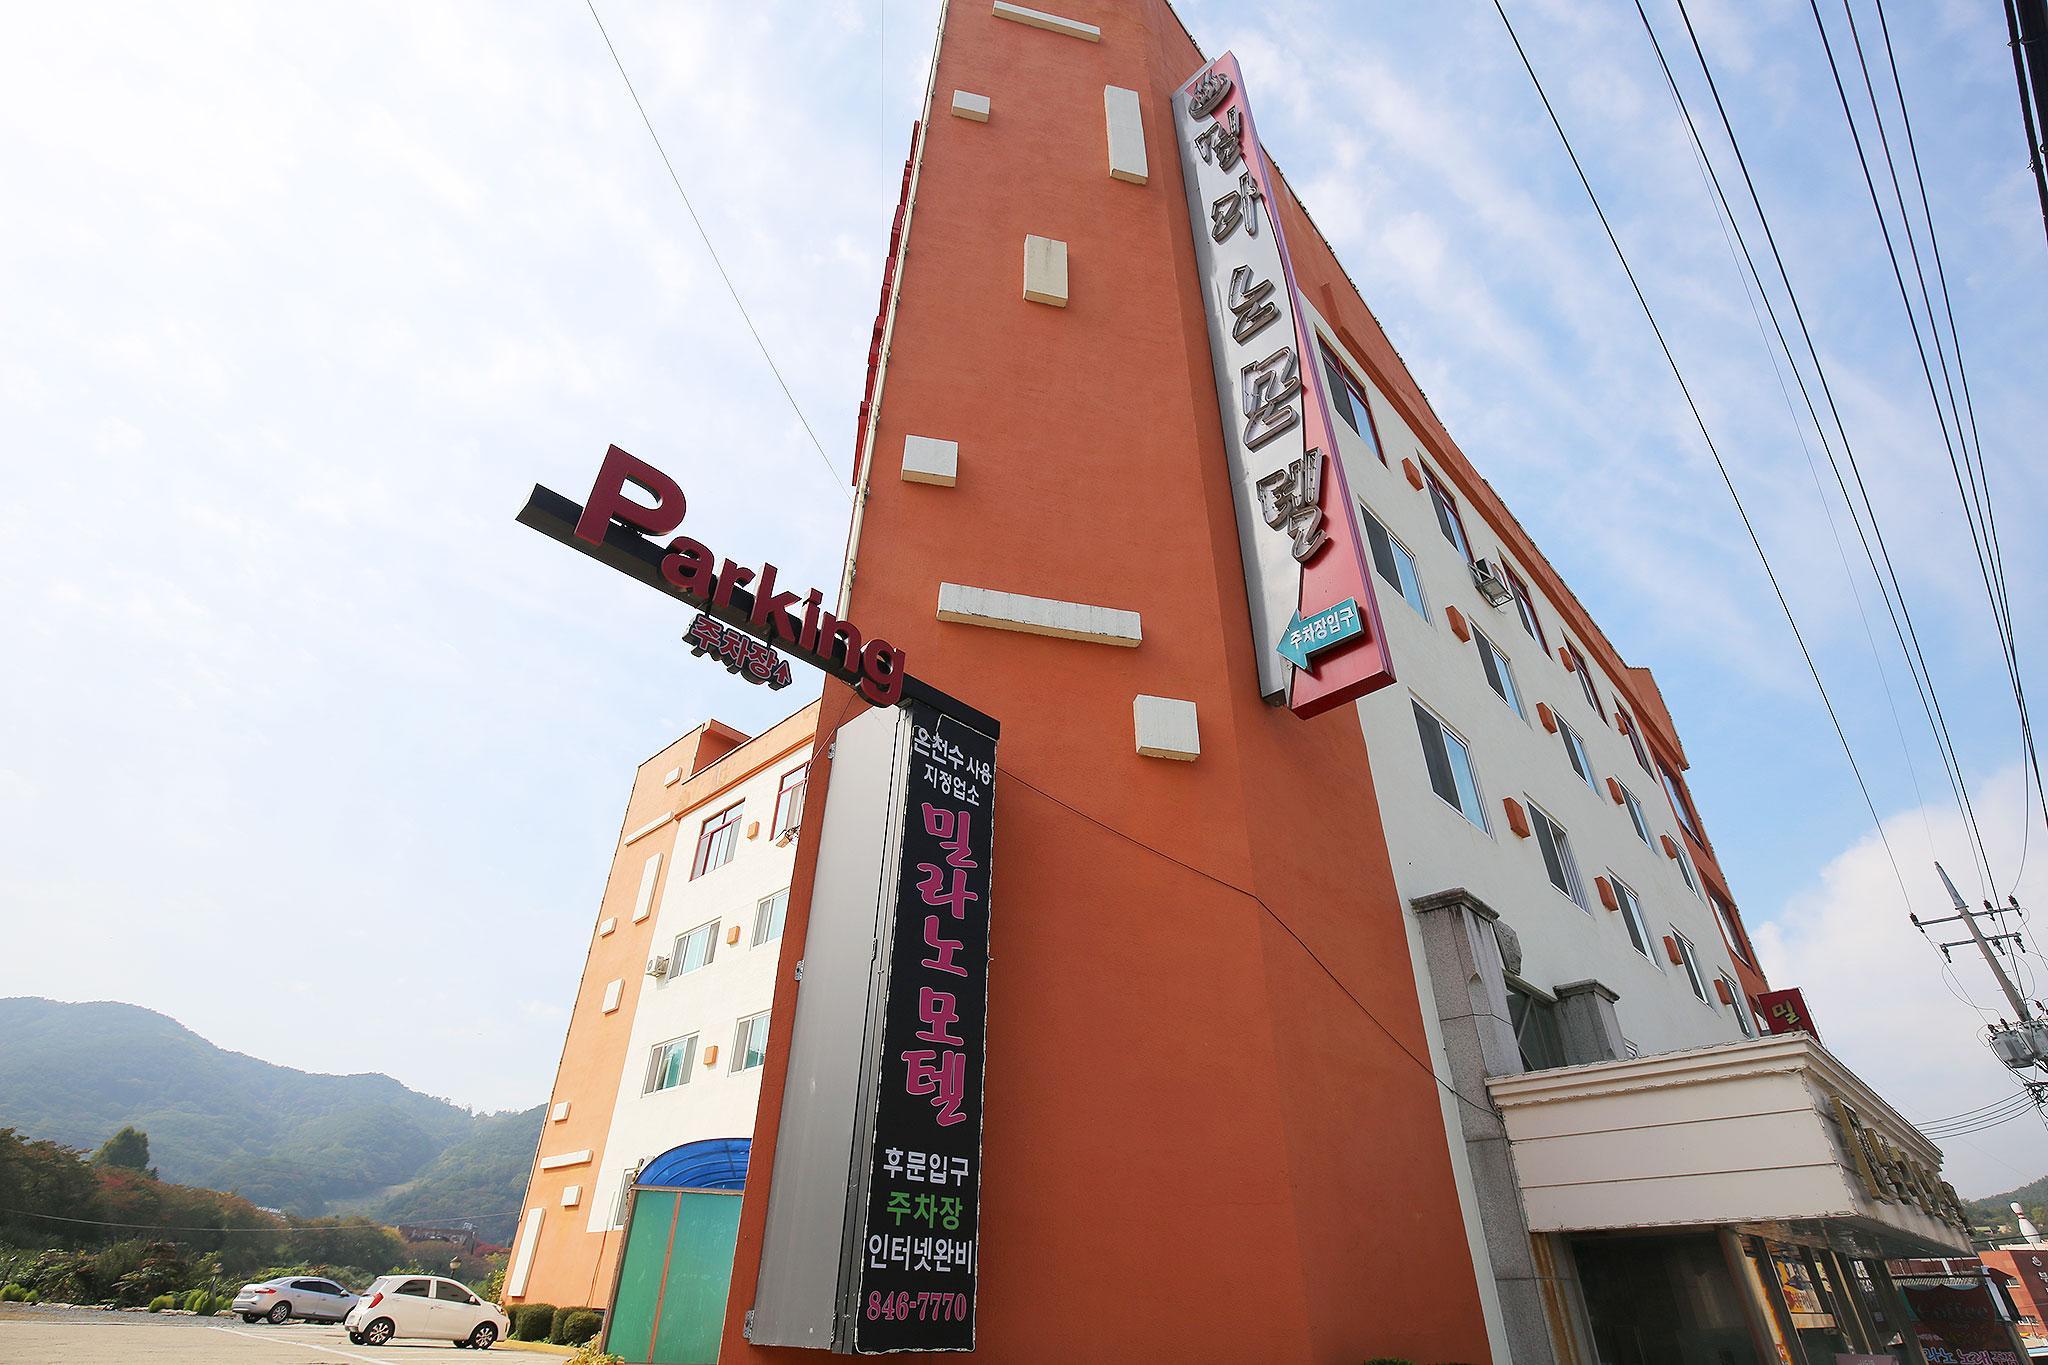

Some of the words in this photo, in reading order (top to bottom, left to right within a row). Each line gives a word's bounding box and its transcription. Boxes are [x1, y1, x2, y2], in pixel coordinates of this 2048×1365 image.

[573, 443, 907, 707] Parking
[690, 614, 779, 680] 주차장
[923, 762, 980, 807] 지정업소
[882, 1146, 970, 1188] 후문입구
[885, 1190, 964, 1231] 주차장
[867, 1232, 973, 1275] 인터넷완비
[865, 1289, 968, 1323] 846-7770
